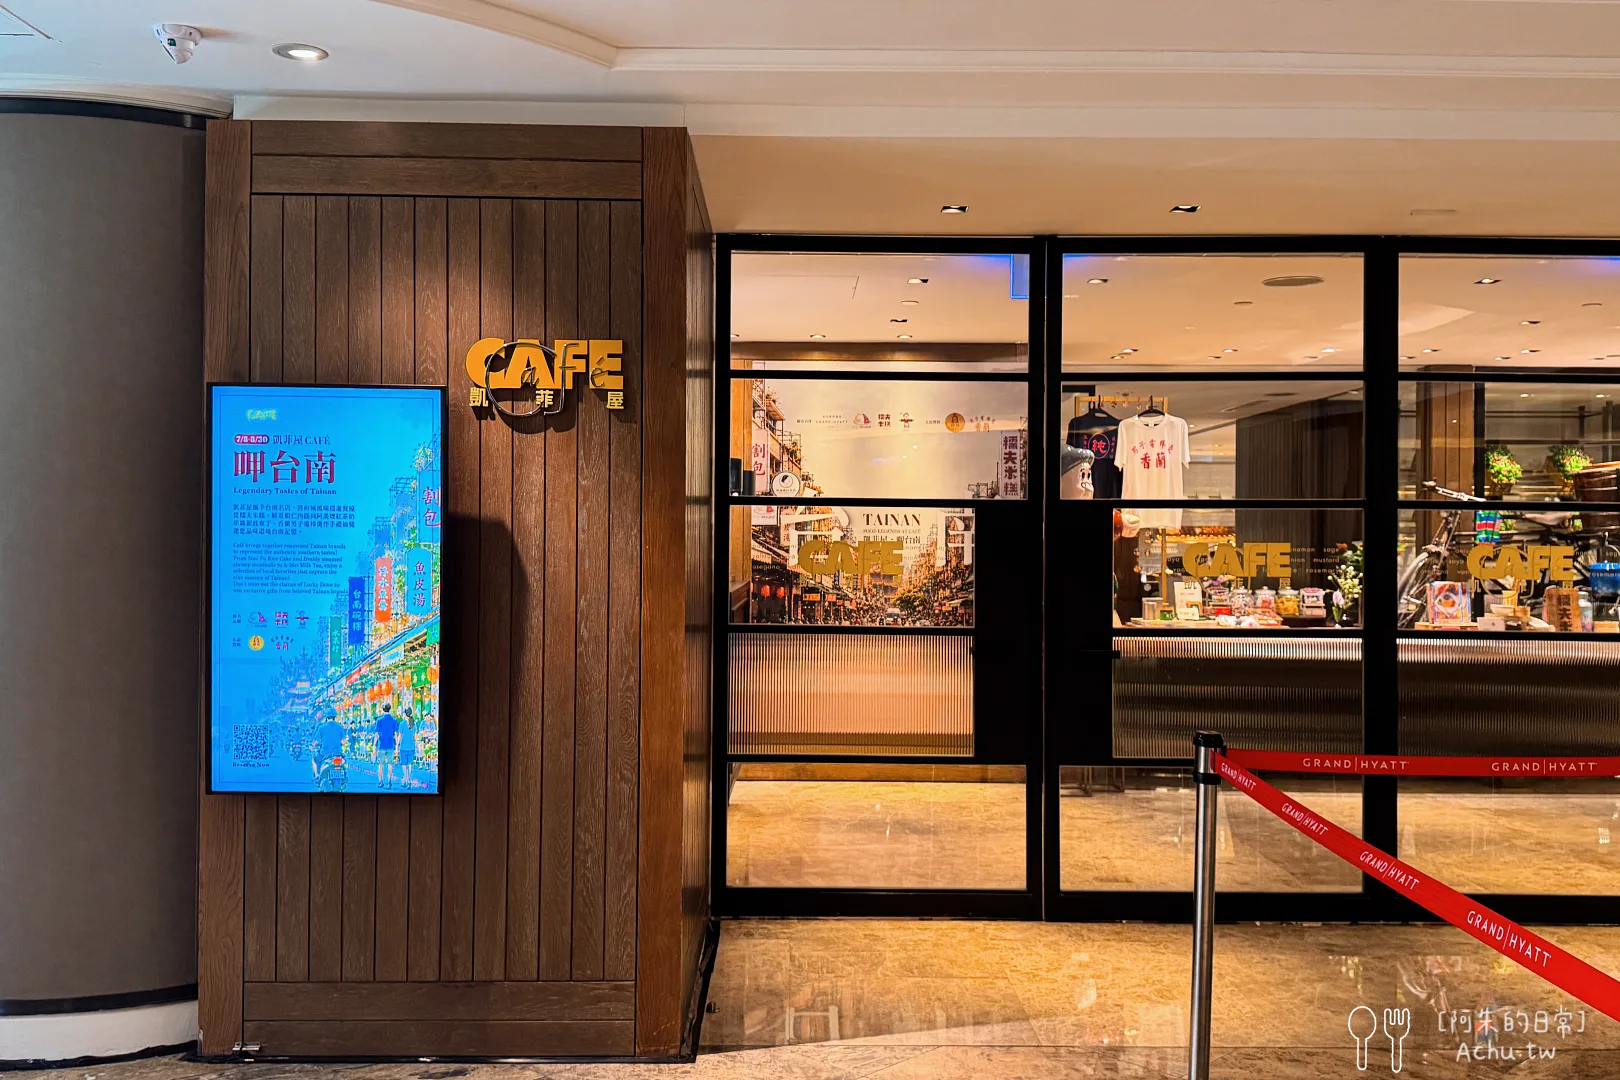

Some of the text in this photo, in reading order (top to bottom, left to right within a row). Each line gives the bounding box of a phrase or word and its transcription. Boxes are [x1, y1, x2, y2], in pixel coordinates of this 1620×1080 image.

[465, 337, 624, 390] CAFE
[469, 387, 625, 410] 凱菲屋
[233, 450, 337, 484] 呷台南
[752, 443, 766, 476] 割包
[1003, 435, 1019, 497] 糯夫米糕
[1141, 452, 1167, 470] 香蘭
[233, 487, 273, 496] Legendary
[274, 487, 299, 495] Tastes
[422, 487, 440, 527] 割包
[862, 513, 921, 526] TAINAN
[798, 539, 904, 576] CAFE
[1183, 542, 1291, 578] CAFE
[1466, 544, 1575, 581] CAFE
[412, 560, 426, 608] 魚皮湯
[1221, 762, 1257, 791] GRAND HYATT
[1303, 758, 1408, 770] GRAND HYATT
[1491, 762, 1597, 772] GRAND HYATT
[1281, 802, 1328, 836] GRAND HYATT
[1359, 851, 1420, 890] GRAND HYATT
[1467, 910, 1551, 968] GRAND HYATT
